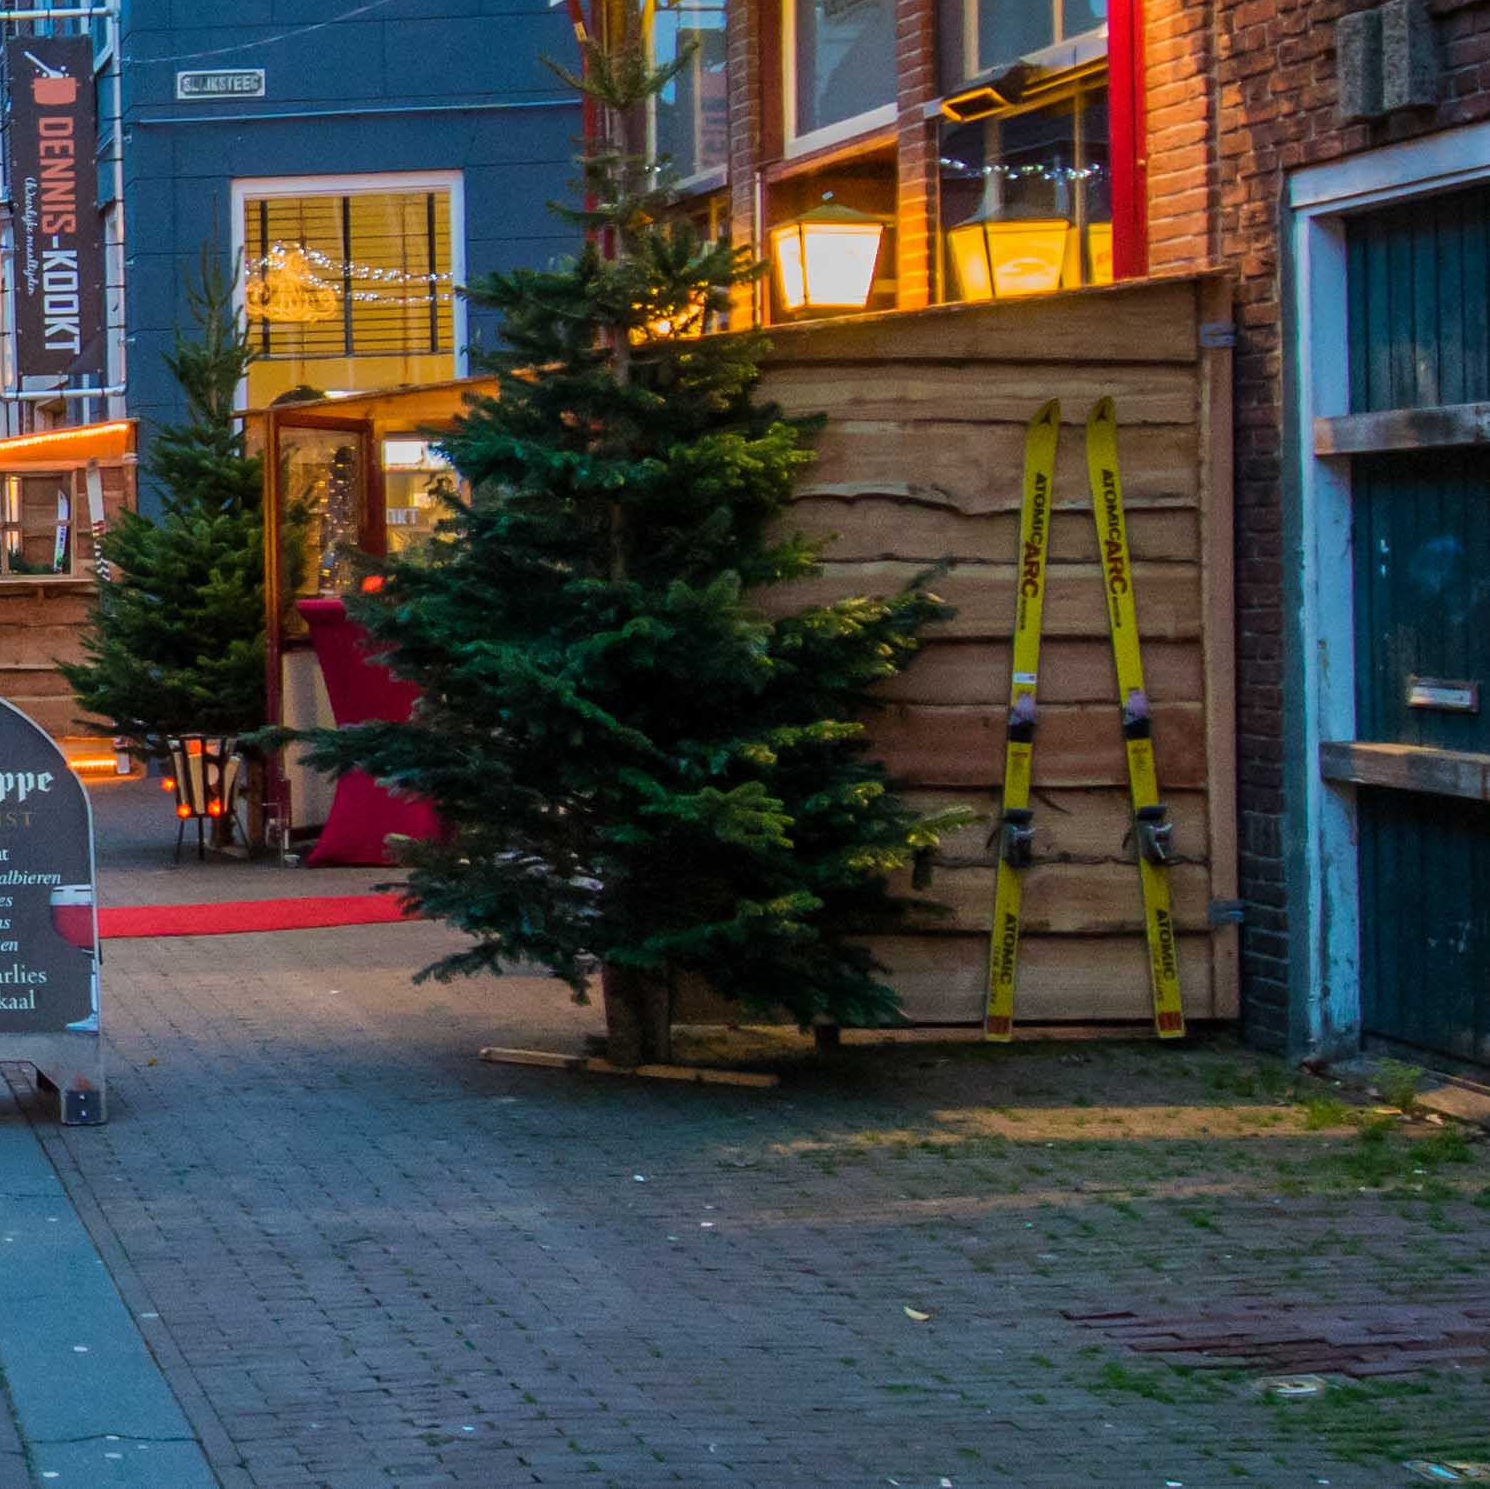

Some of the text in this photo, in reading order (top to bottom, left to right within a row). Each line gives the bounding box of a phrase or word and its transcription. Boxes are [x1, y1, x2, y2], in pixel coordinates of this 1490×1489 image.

[38, 116, 82, 355] DENNIS-KOOKT
[1030, 473, 1048, 544] ATOMIC
[1102, 469, 1121, 540] ATOMIC
[1022, 542, 1041, 598] ARC
[1105, 541, 1127, 595] ARC
[1000, 912, 1017, 986] ATOMIC
[1155, 908, 1176, 981] ATOMIC
